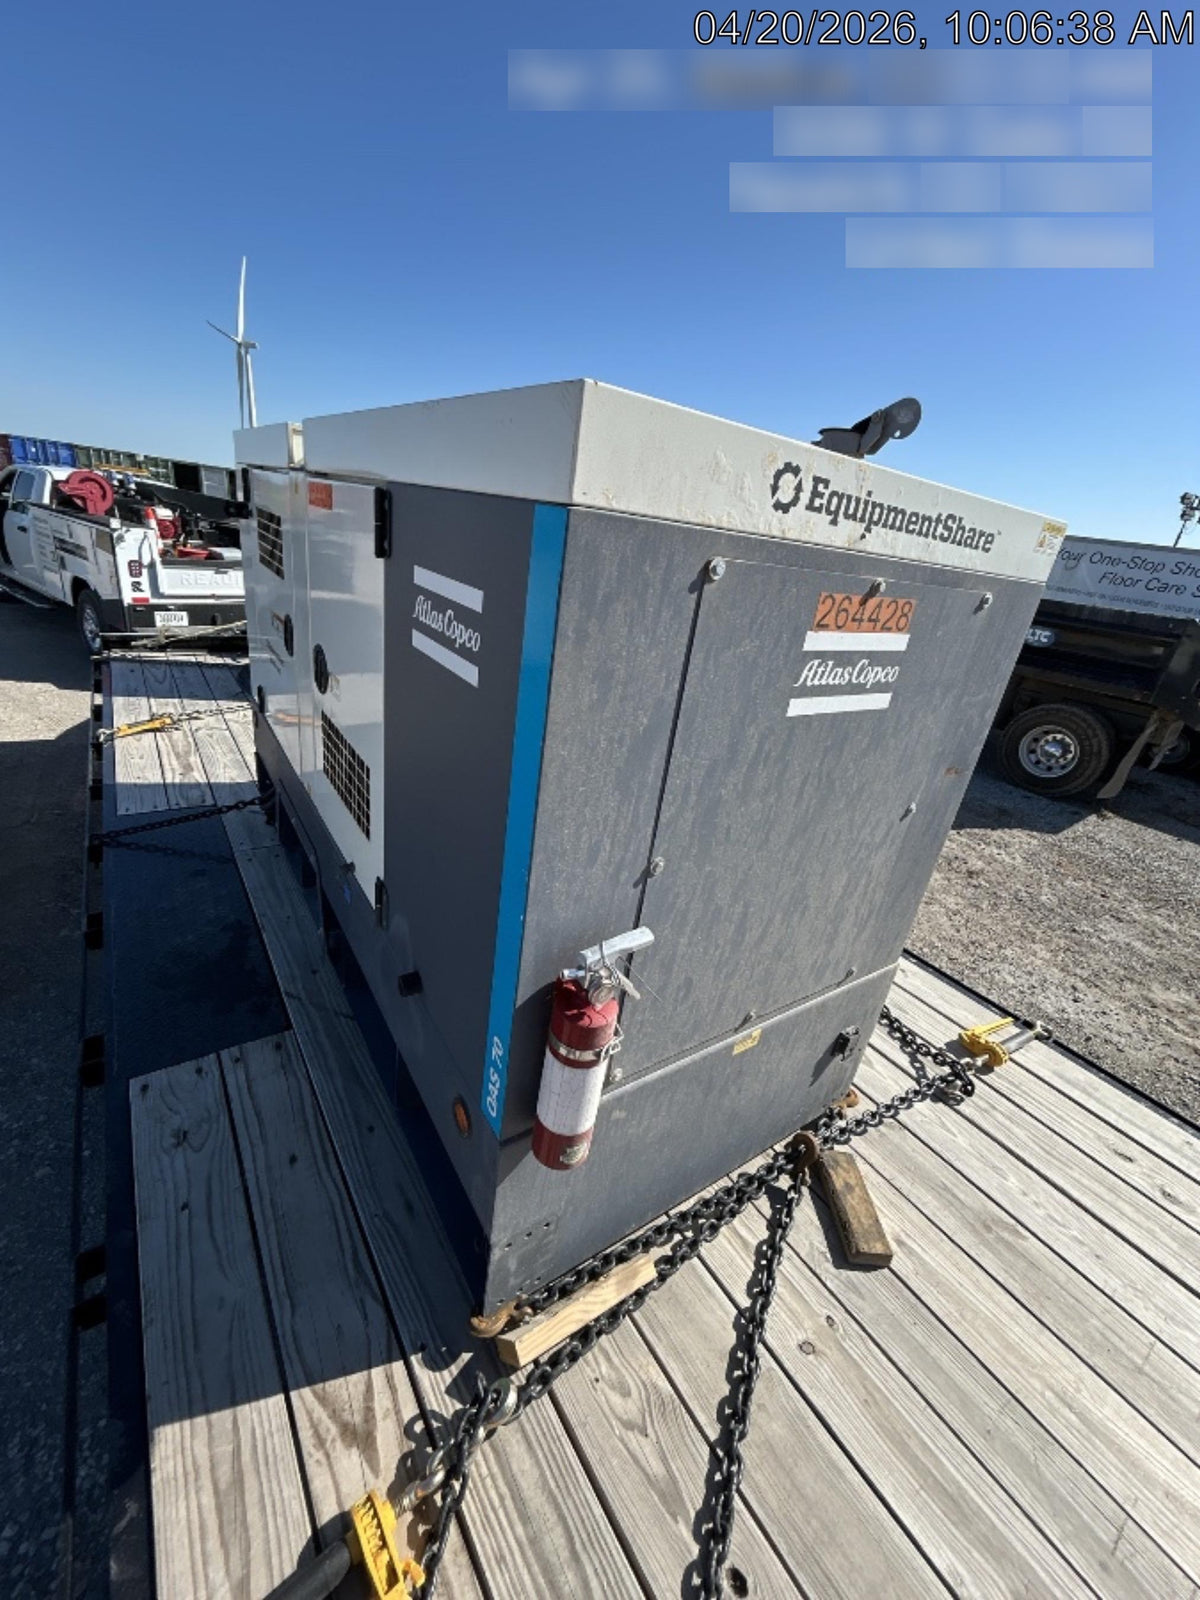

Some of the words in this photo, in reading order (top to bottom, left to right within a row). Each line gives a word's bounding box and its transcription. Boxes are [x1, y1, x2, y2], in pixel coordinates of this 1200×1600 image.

[805, 475, 995, 553] EquipmentShare
[1089, 551, 1166, 576] One-Stop
[1098, 571, 1143, 589] Floor
[1144, 577, 1187, 596] Care
[815, 593, 913, 632] 264428
